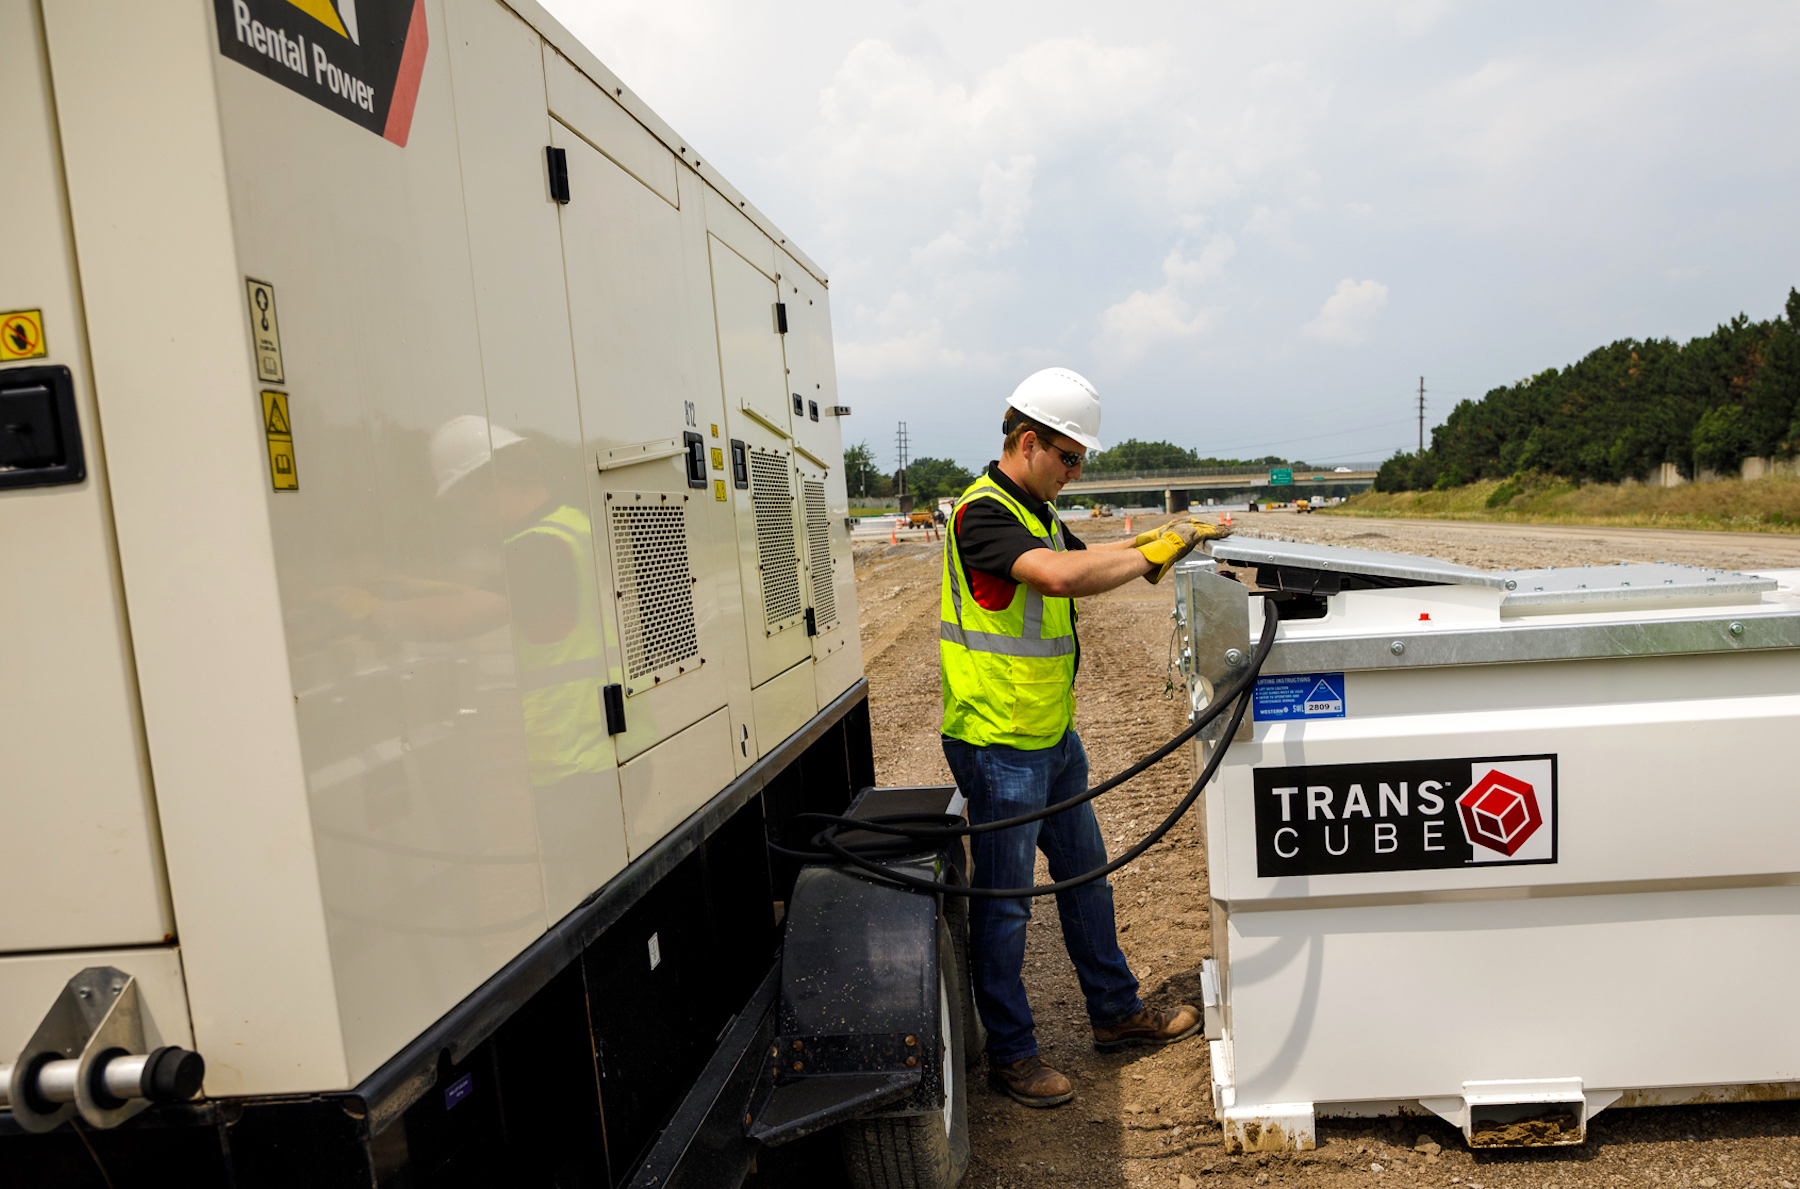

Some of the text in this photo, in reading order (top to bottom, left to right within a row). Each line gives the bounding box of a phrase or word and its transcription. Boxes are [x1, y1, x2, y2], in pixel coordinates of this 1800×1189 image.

[232, 0, 375, 114] Rental Power
[1272, 780, 1446, 821] TRANS
[1274, 820, 1446, 858] CUBE
